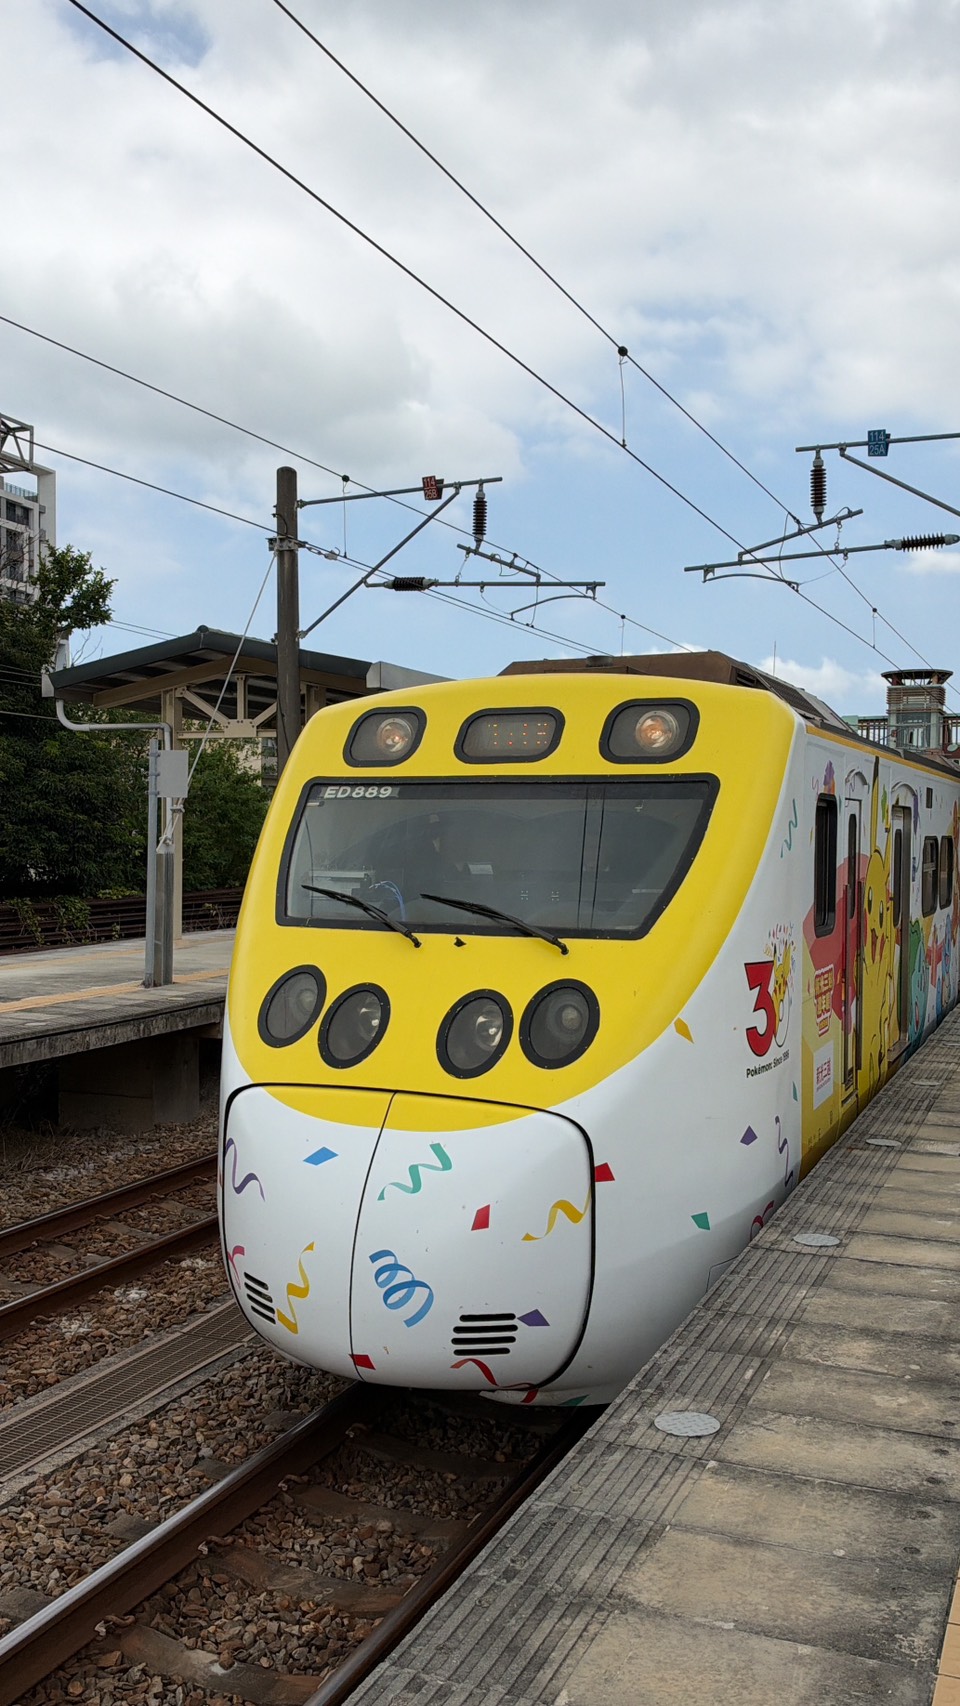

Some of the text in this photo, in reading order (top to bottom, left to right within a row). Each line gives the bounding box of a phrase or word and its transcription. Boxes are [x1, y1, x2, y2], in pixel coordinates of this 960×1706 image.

[870, 431, 885, 442] 114
[870, 444, 886, 456] 25A
[423, 476, 436, 488] 114
[323, 785, 393, 799] ED889
